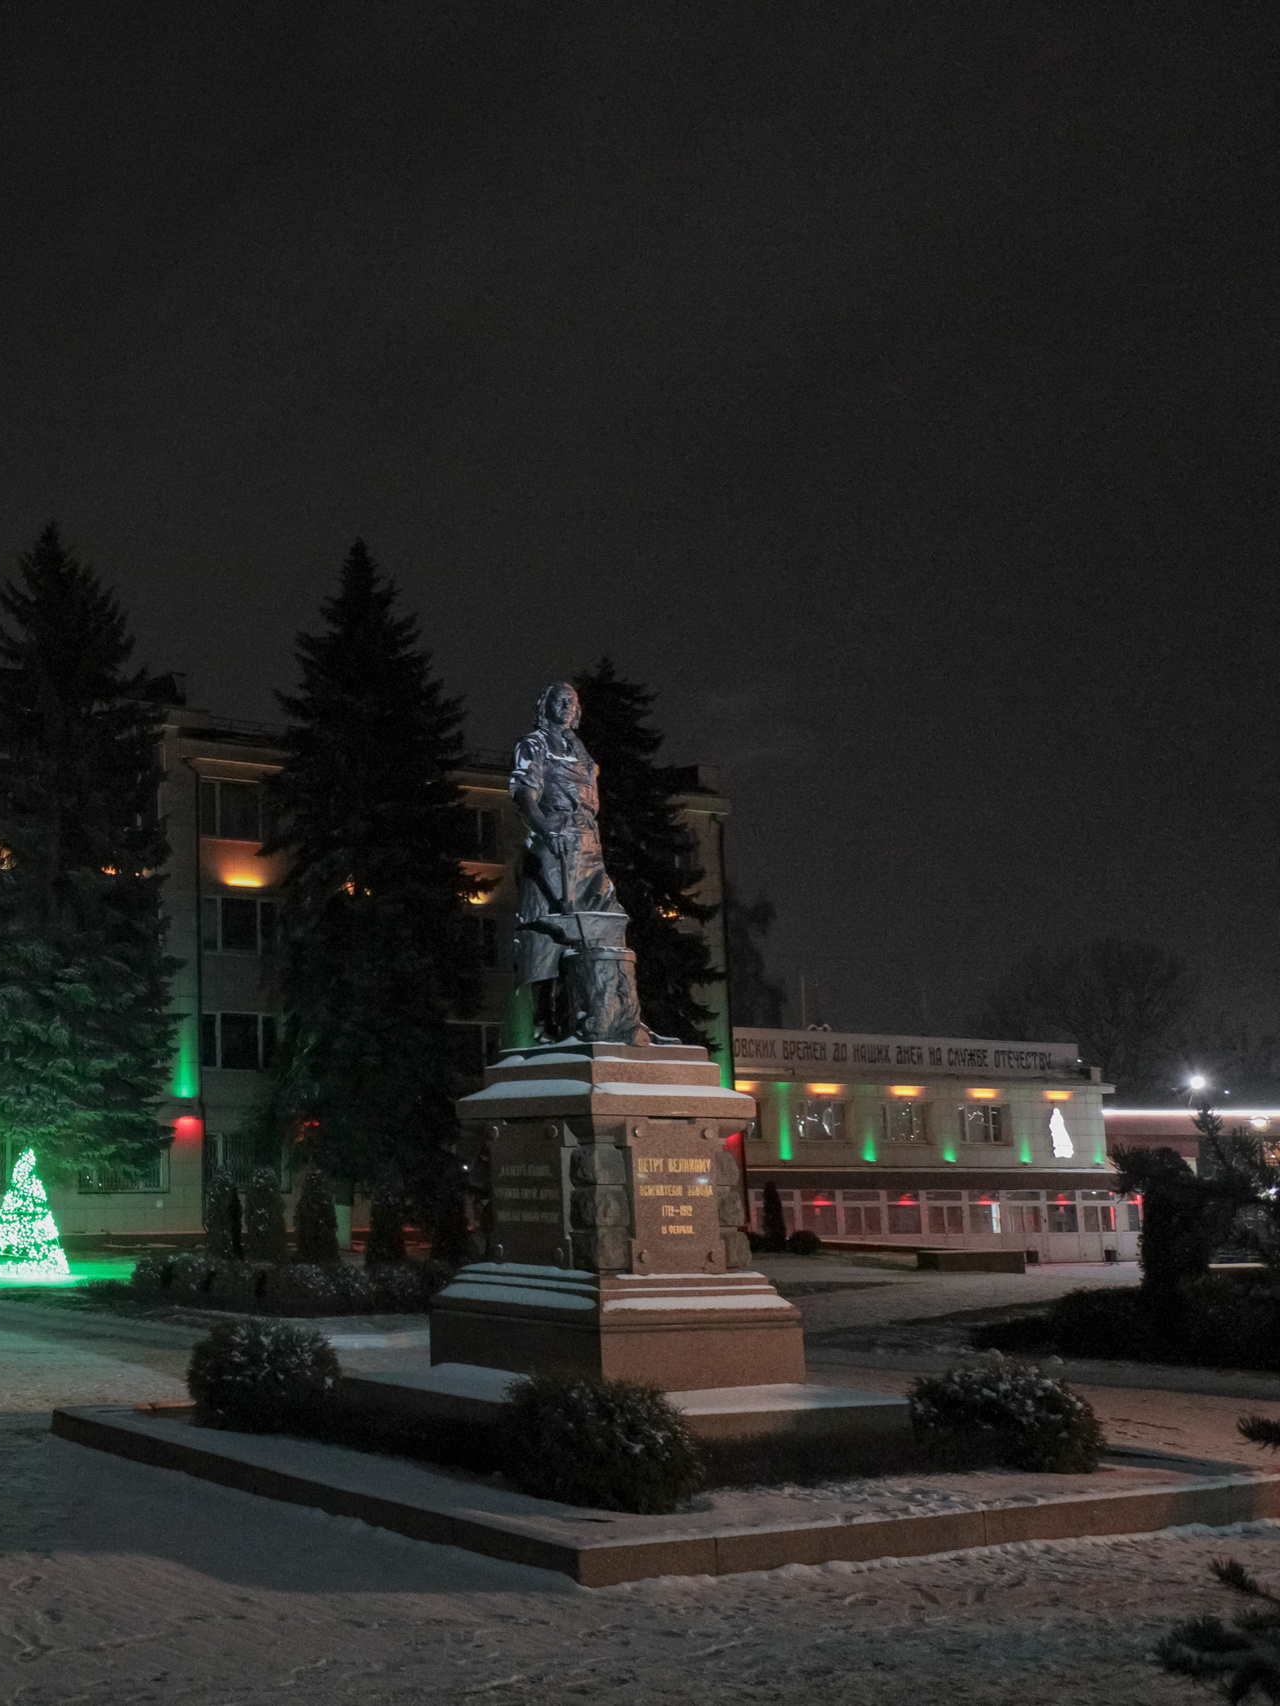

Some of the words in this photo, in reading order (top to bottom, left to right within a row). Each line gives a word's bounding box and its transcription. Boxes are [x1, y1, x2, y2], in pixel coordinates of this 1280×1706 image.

[833, 1042, 847, 1062] ДО
[853, 1043, 890, 1064] НАШИХ
[896, 1045, 923, 1066] ДНЕЙ
[928, 1047, 942, 1066] НА
[948, 1047, 989, 1068] СЛУЖБЕ
[994, 1050, 1052, 1070] ОТЕЧЕСТВУ
[637, 1158, 663, 1173] ПЕТРУ
